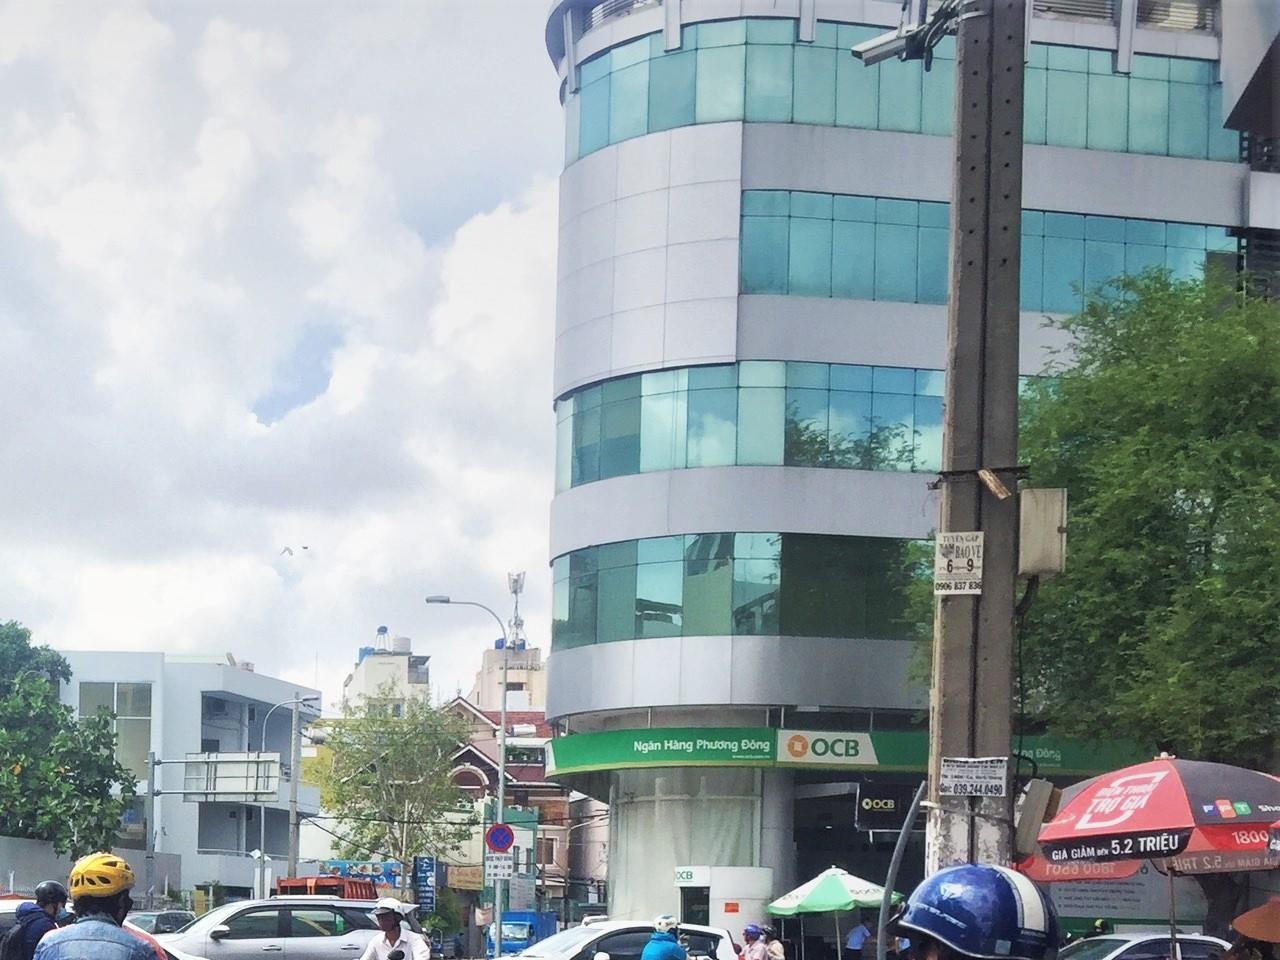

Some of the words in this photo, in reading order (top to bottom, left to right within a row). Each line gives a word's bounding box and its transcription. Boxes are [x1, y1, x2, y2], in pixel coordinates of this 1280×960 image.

[947, 559, 953, 573] 6
[966, 558, 974, 572] 9
[633, 740, 661, 753] Ngân
[664, 740, 693, 753] Hàng
[696, 739, 739, 752] Phương
[741, 739, 771, 753] Đông
[811, 738, 860, 758] OCB
[872, 799, 895, 809] OCB
[1202, 801, 1251, 816] FPT
[1232, 831, 1269, 845] 1800
[1071, 845, 1096, 859] GIẢM
[1111, 839, 1133, 855] 5.2
[1138, 833, 1179, 854] TRIỆU
